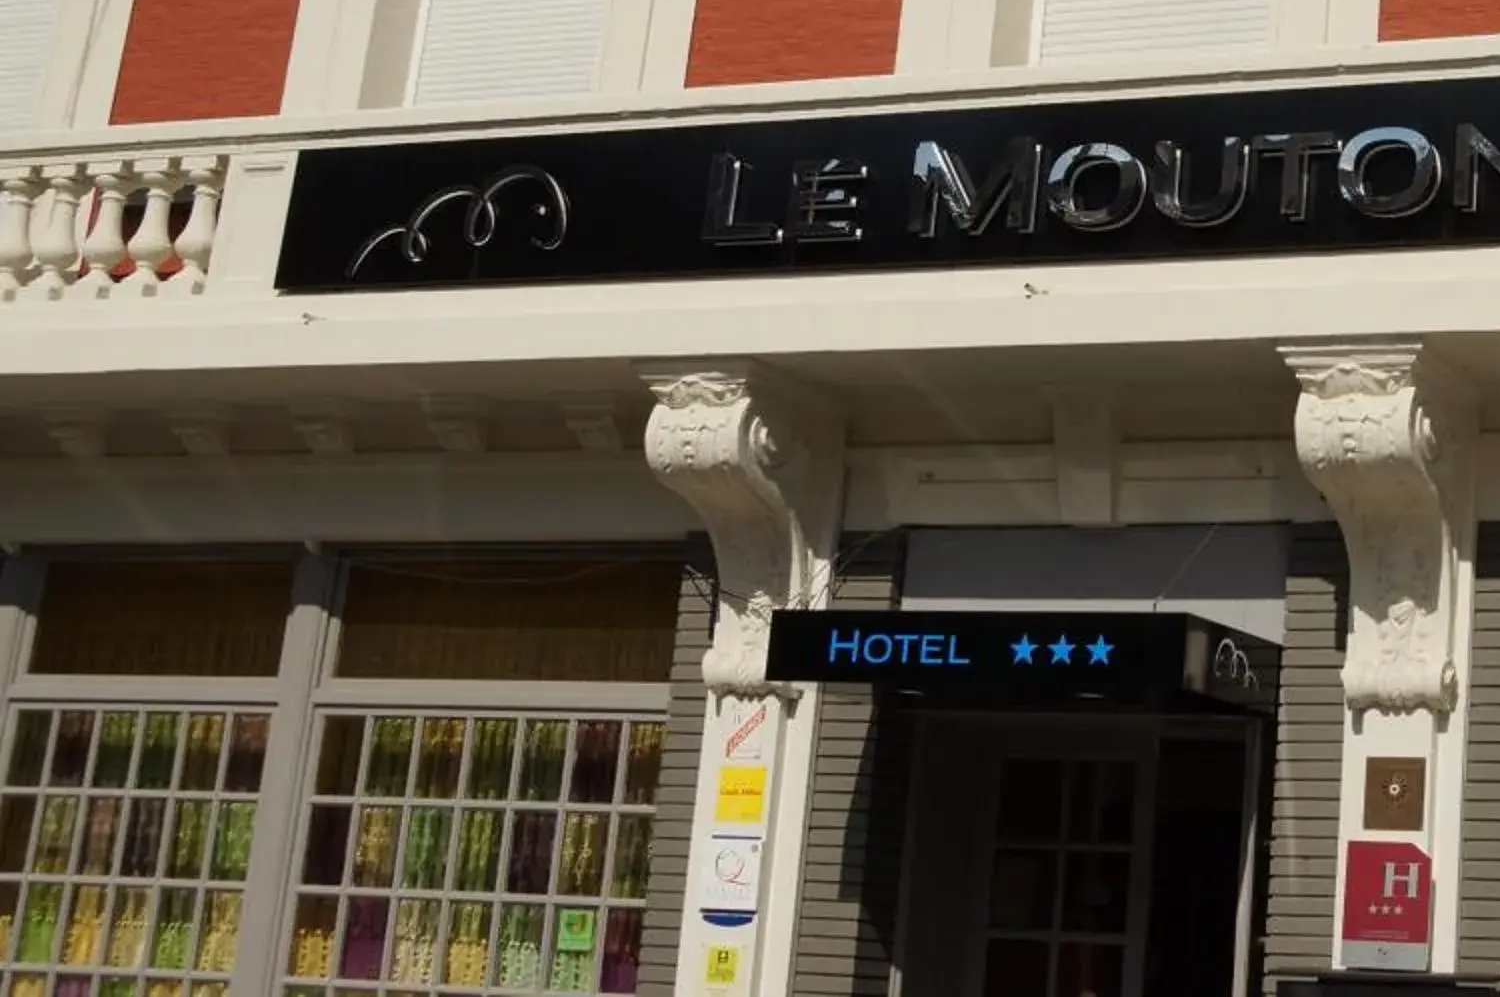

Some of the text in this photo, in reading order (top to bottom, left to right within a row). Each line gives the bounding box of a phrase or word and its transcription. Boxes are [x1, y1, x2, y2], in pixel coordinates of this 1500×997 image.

[702, 151, 868, 246] LE
[829, 628, 971, 664] HOTEL
[1382, 861, 1422, 898] H
